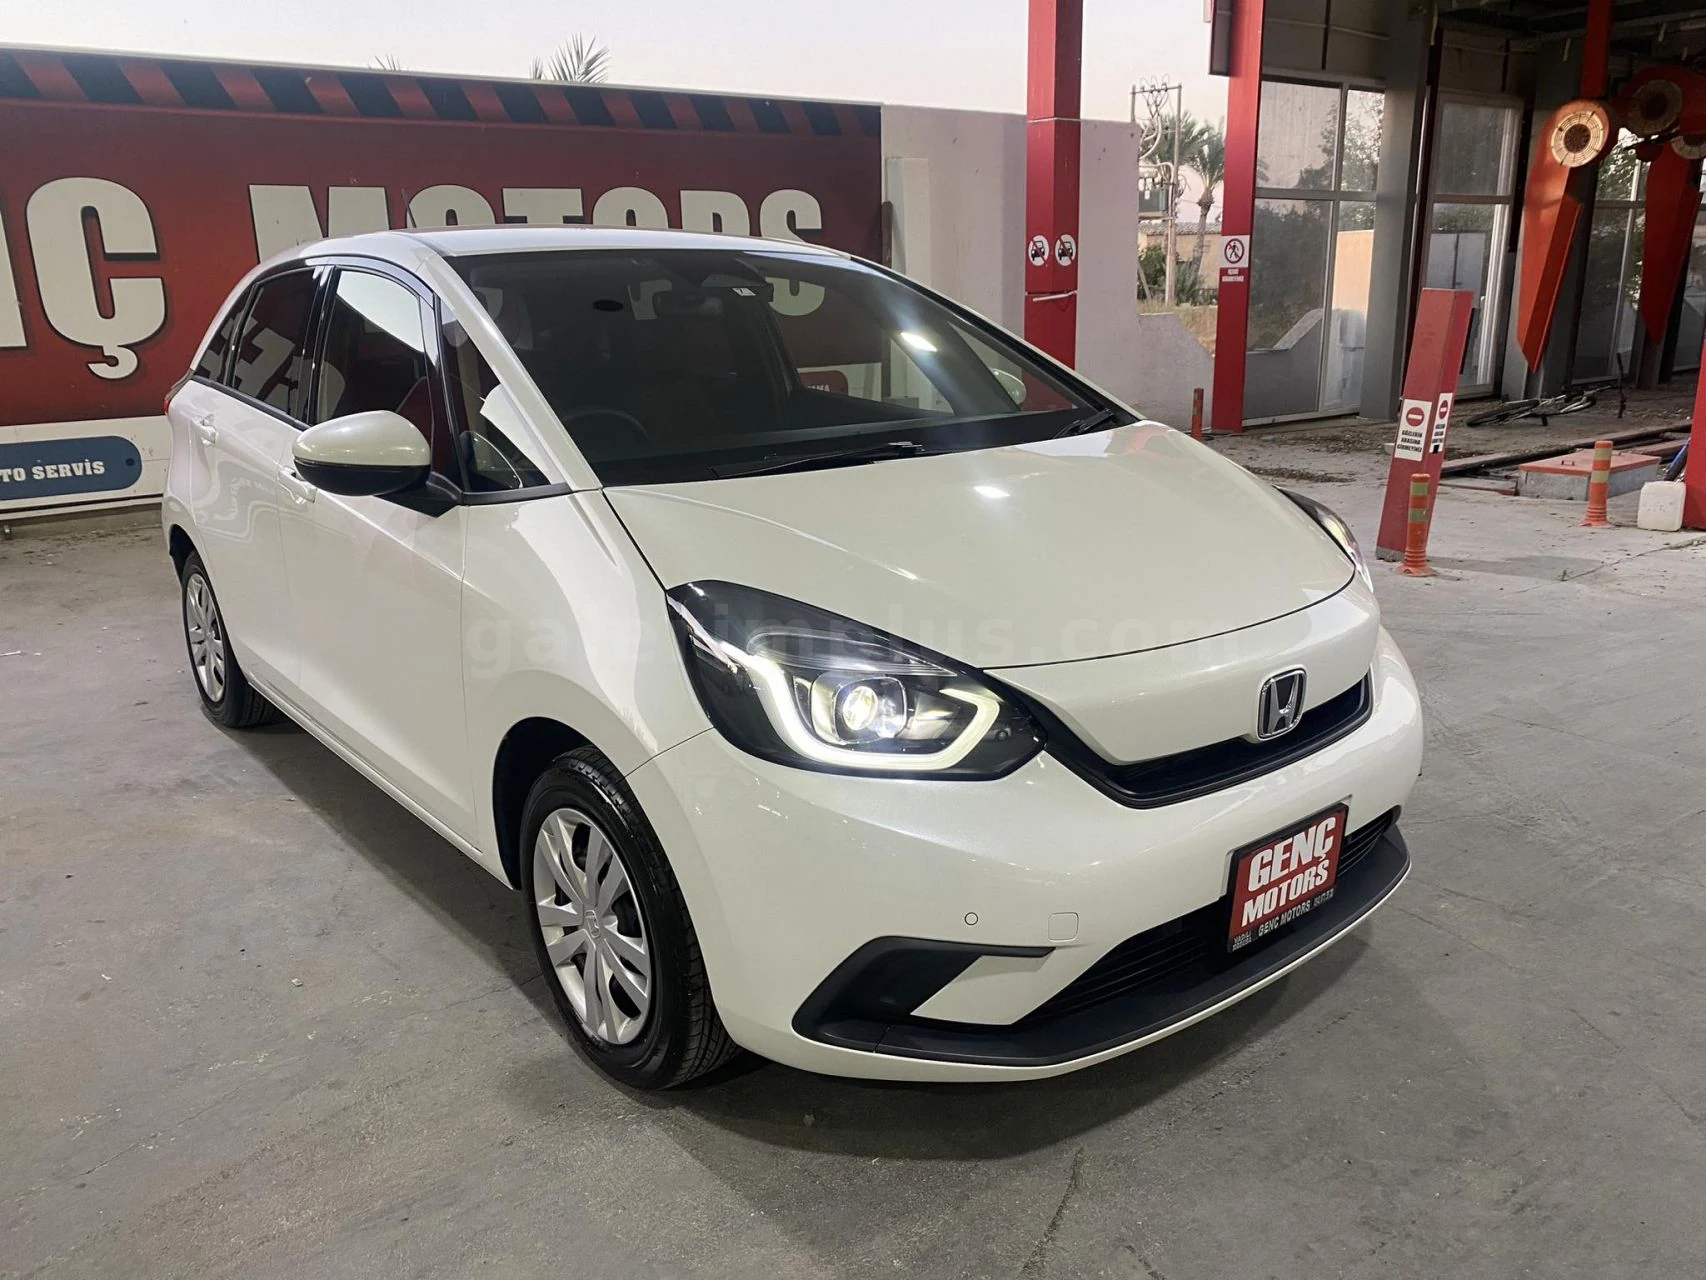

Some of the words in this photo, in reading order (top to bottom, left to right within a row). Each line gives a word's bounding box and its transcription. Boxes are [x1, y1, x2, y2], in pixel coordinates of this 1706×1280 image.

[0, 177, 166, 379] Ç
[32, 458, 106, 480] SERVİS
[1247, 816, 1336, 892] GENÇ
[1241, 858, 1329, 928] MOTORS
[1280, 899, 1311, 926] MOTORS
